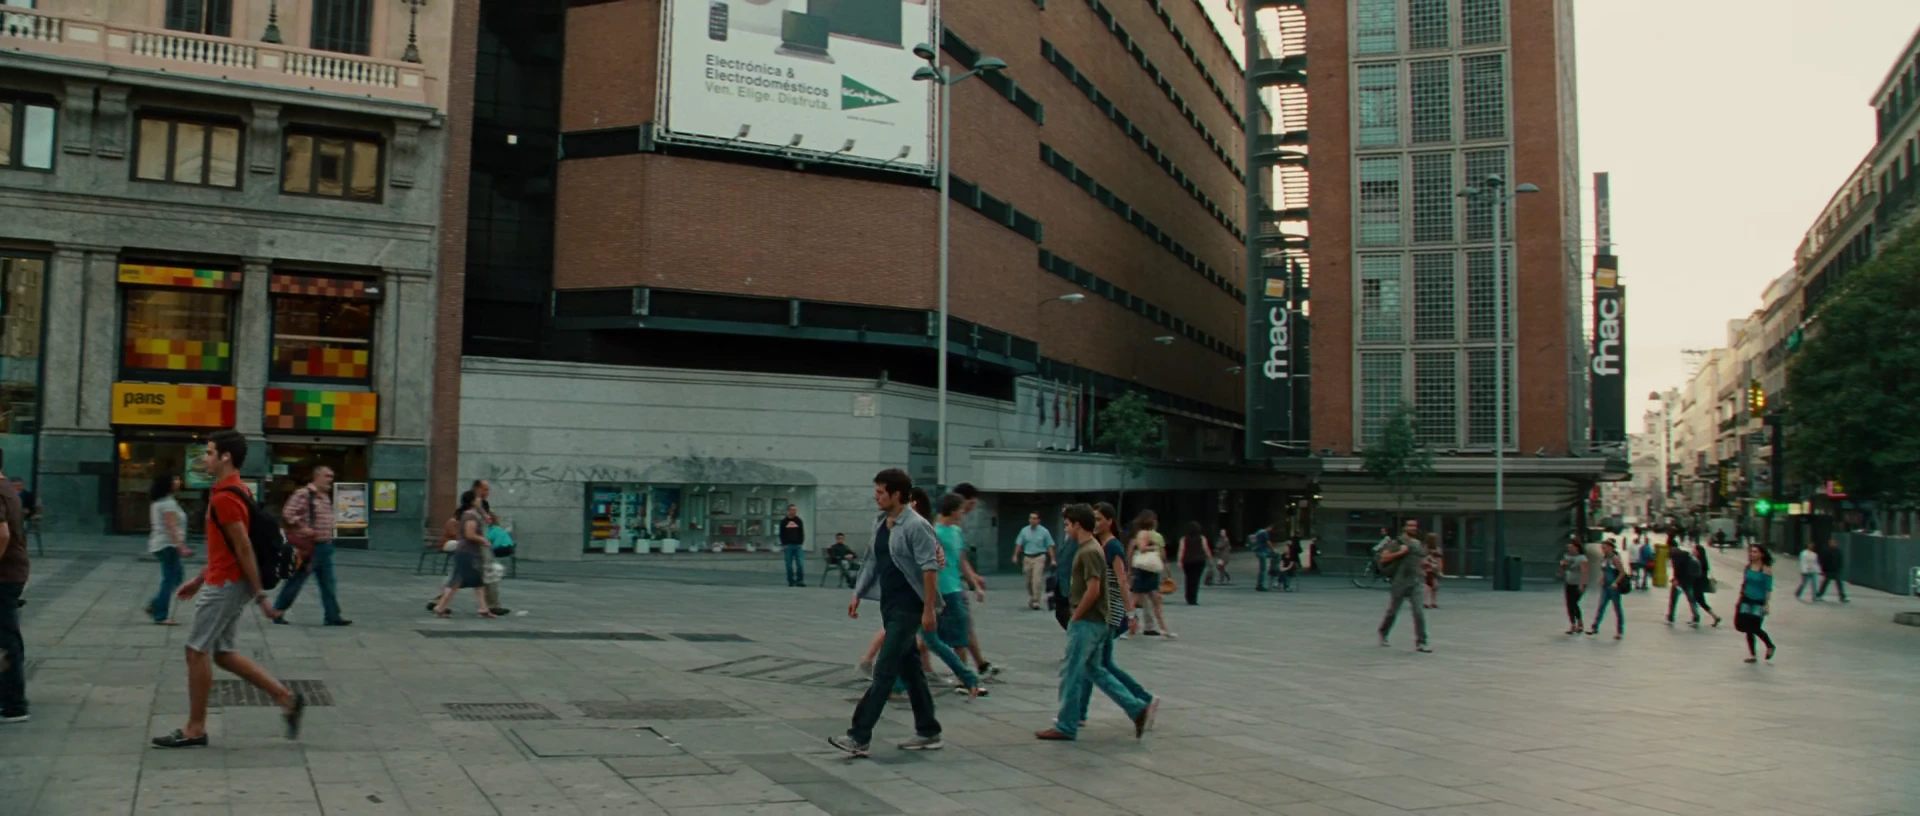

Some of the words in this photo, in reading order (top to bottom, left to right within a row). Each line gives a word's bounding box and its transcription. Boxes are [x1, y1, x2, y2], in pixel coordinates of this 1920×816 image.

[706, 54, 782, 76] Electrónica
[786, 67, 795, 79] &
[705, 81, 734, 95] Ven.
[738, 86, 774, 102] Elige.
[778, 92, 831, 110] Disfruta.
[706, 67, 829, 97] Electrodomésticos
[1263, 307, 1288, 379] fnac
[1592, 298, 1619, 376] fnac
[124, 392, 165, 408] pans
